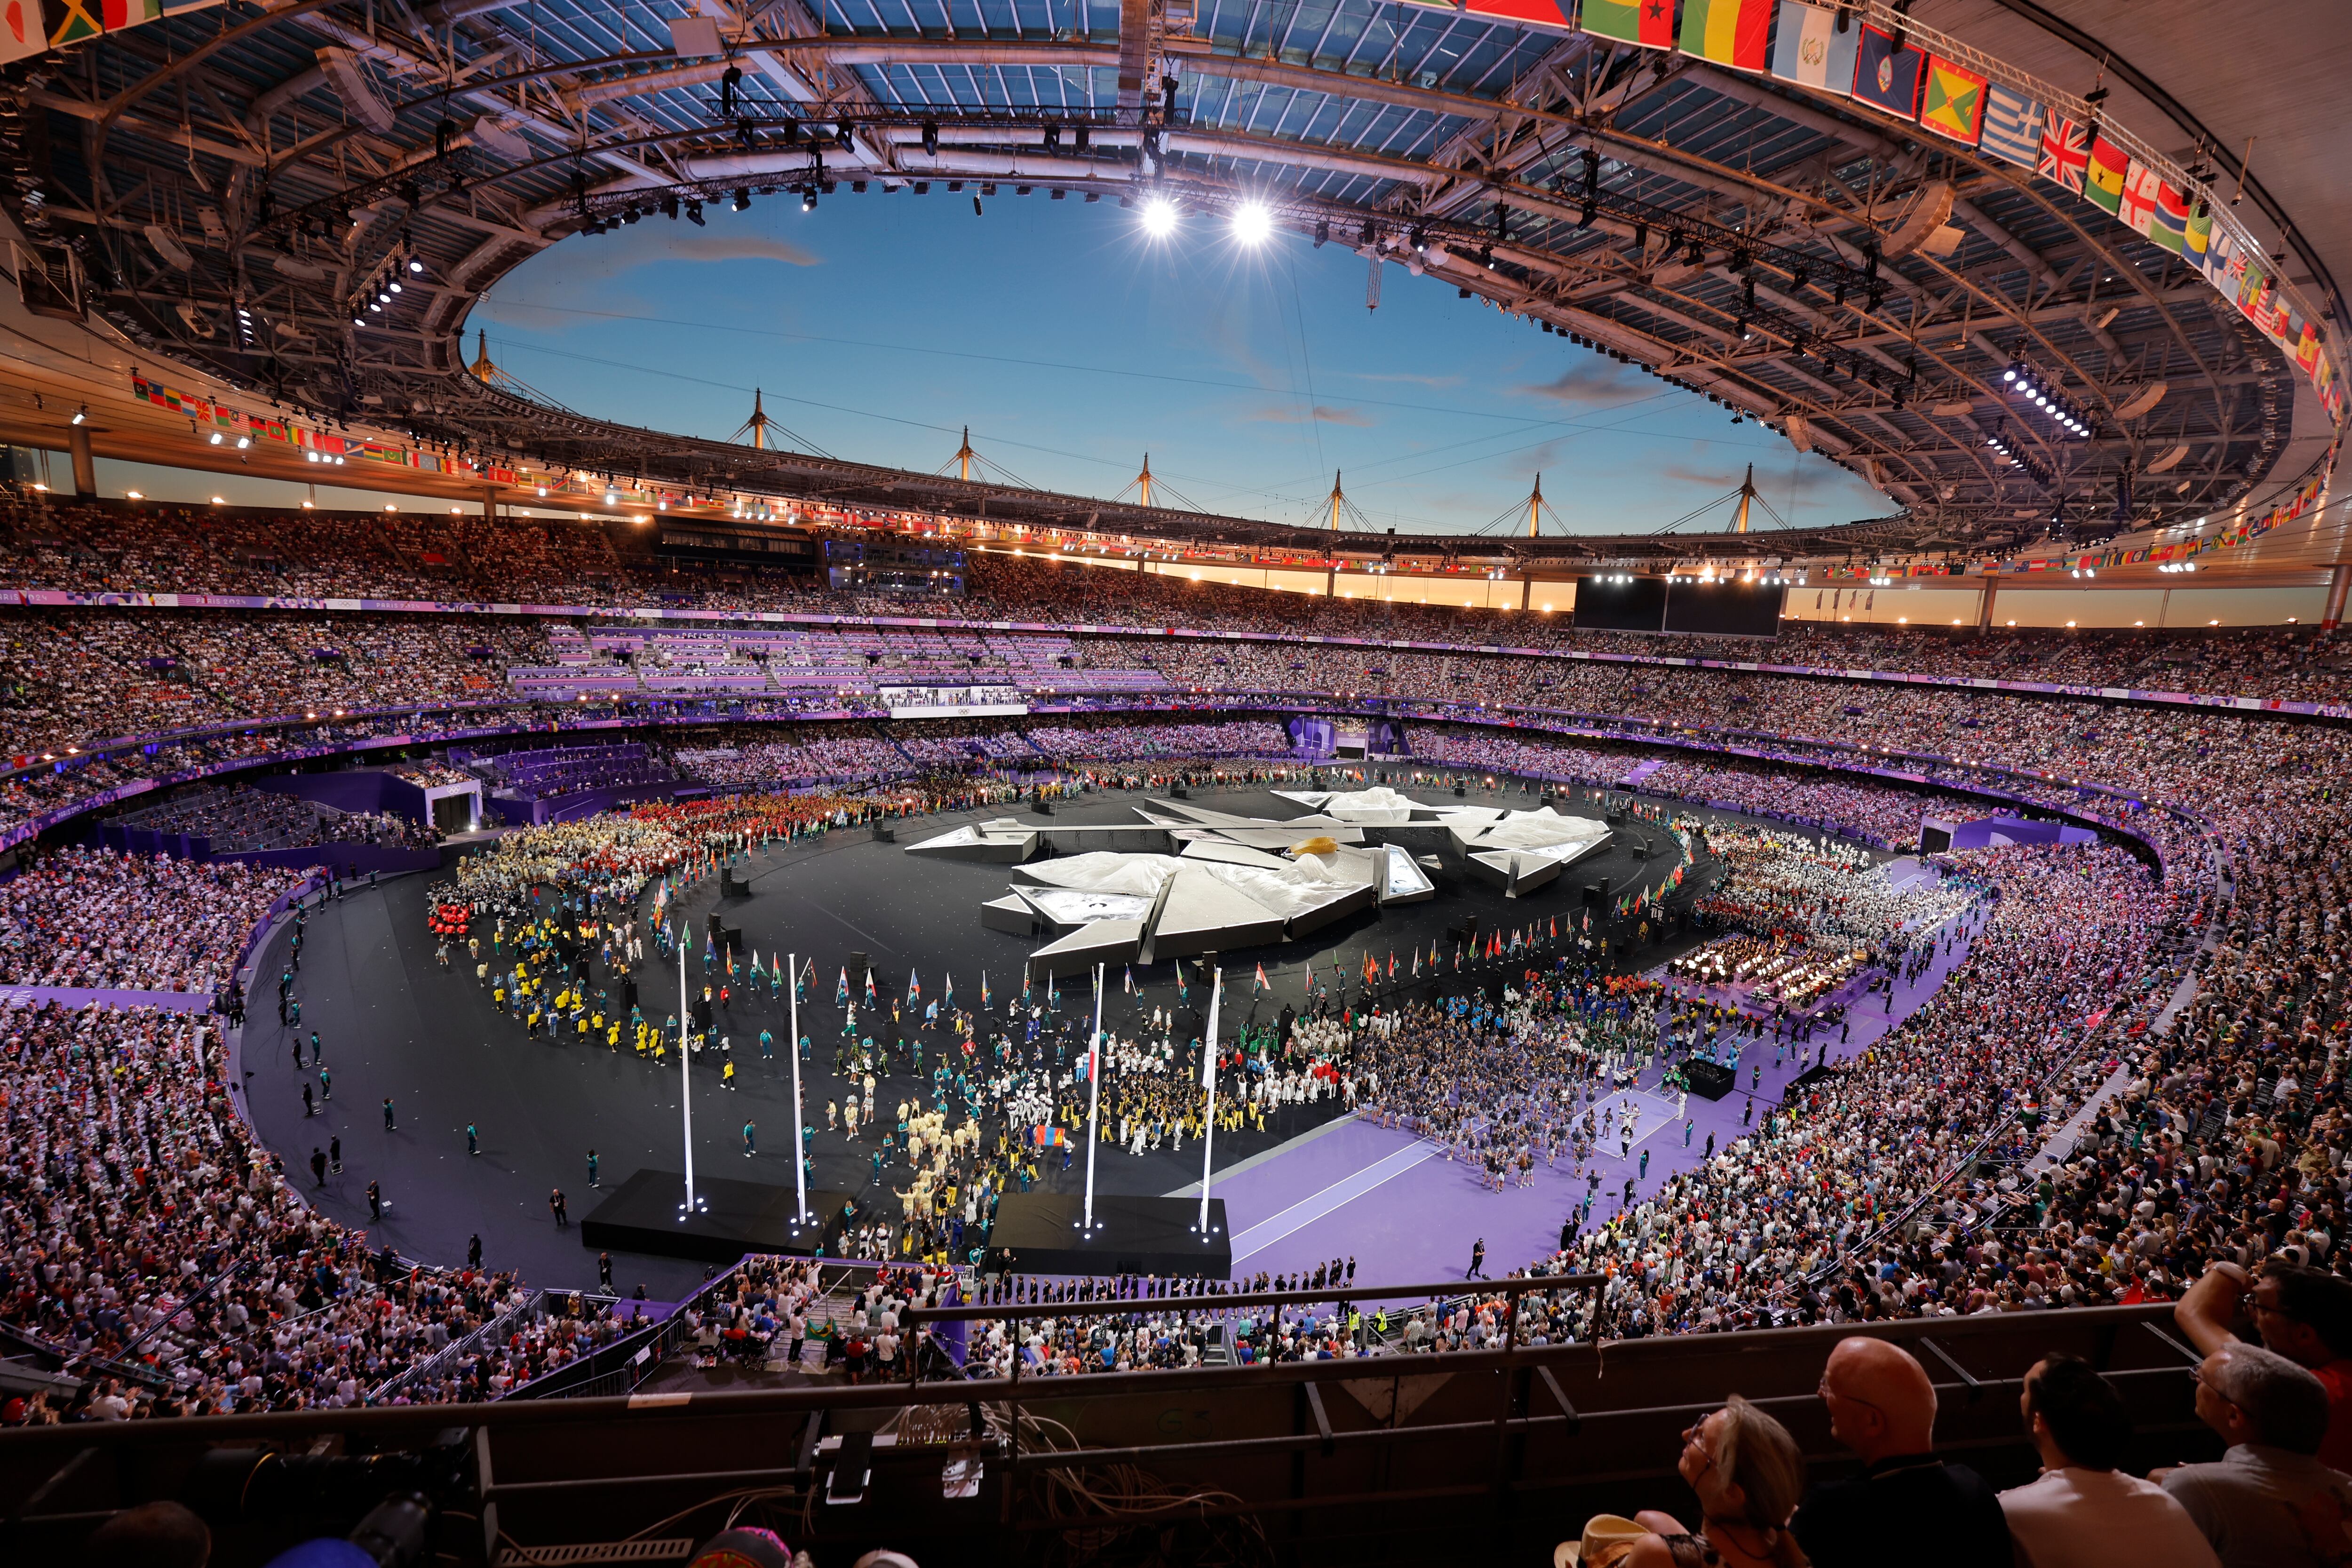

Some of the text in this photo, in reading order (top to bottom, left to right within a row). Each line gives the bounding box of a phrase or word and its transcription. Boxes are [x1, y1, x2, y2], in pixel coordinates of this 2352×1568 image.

[122, 782, 151, 795] PARIS 2024
[57, 804, 82, 819] PARIS 2024
